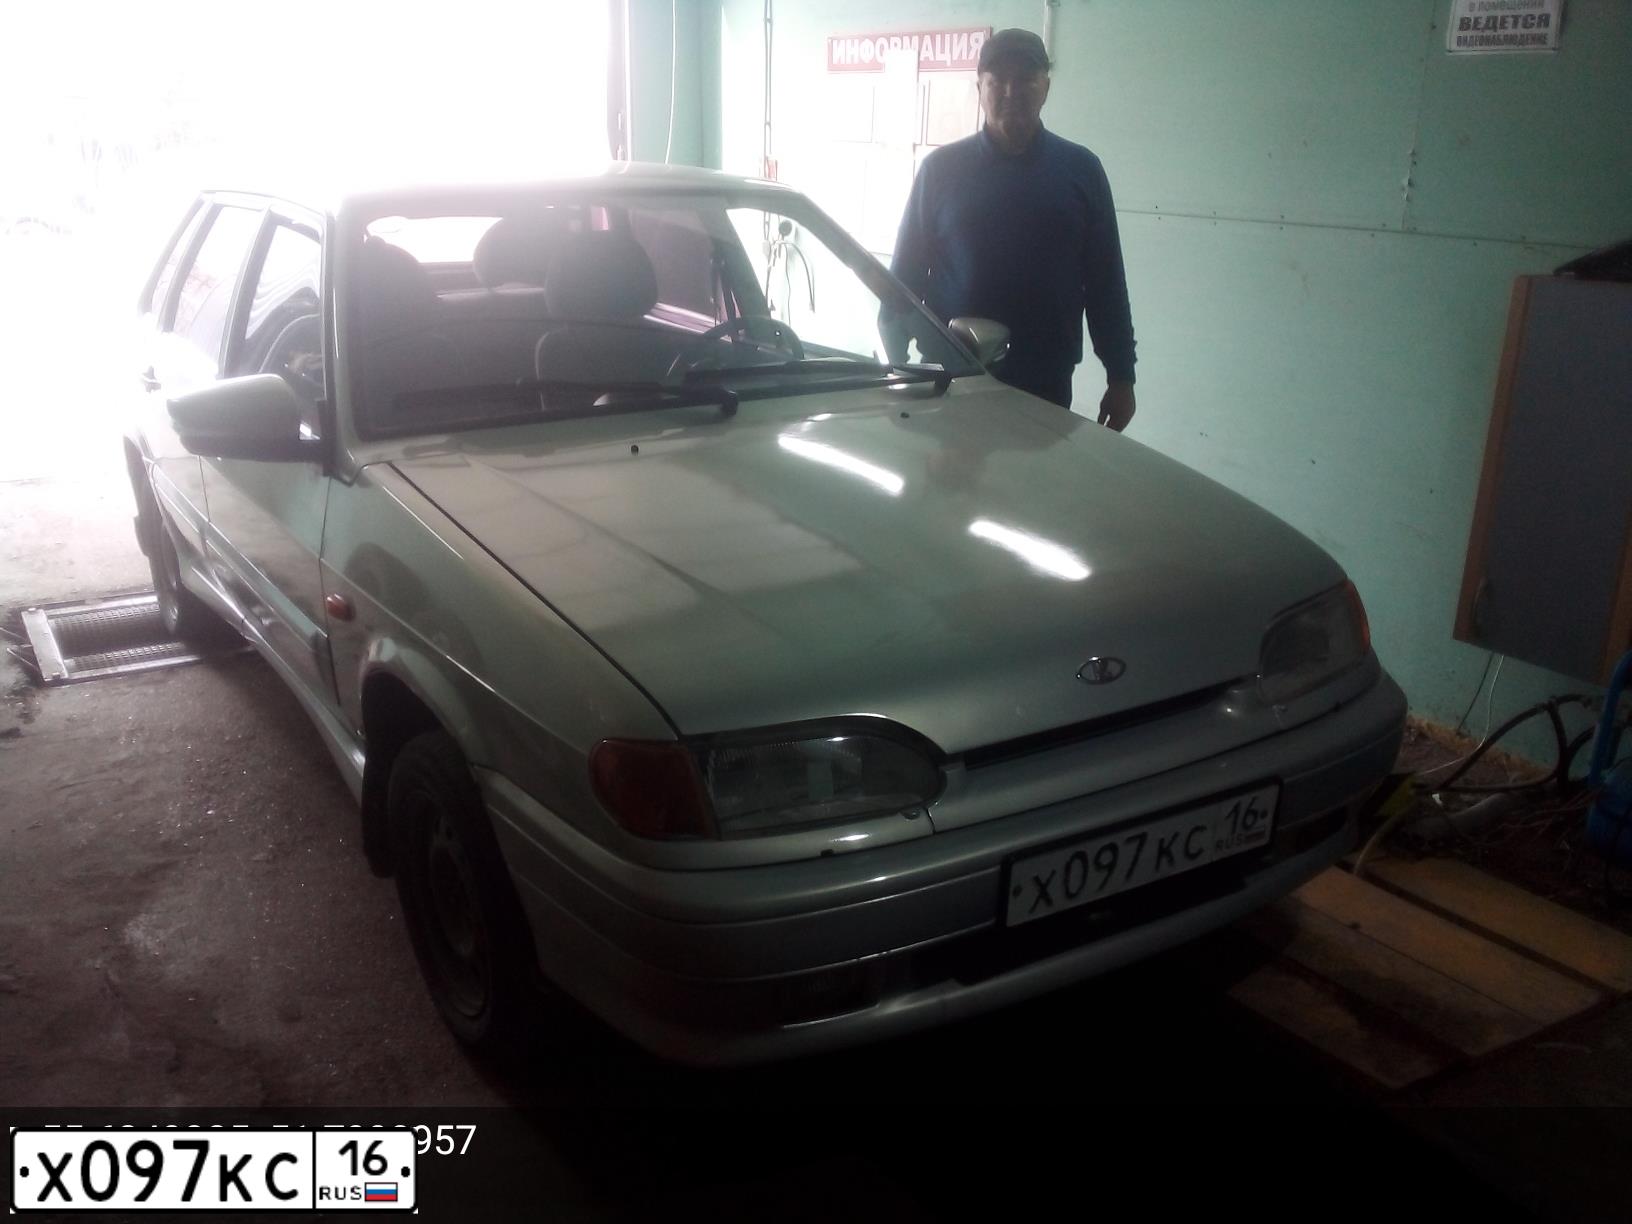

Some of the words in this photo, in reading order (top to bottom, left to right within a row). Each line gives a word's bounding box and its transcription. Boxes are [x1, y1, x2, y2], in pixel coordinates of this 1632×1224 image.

[1458, 13, 1551, 32] ВЕДЕТСЯ
[1224, 796, 1259, 833] 16
[1216, 831, 1243, 850] RUS
